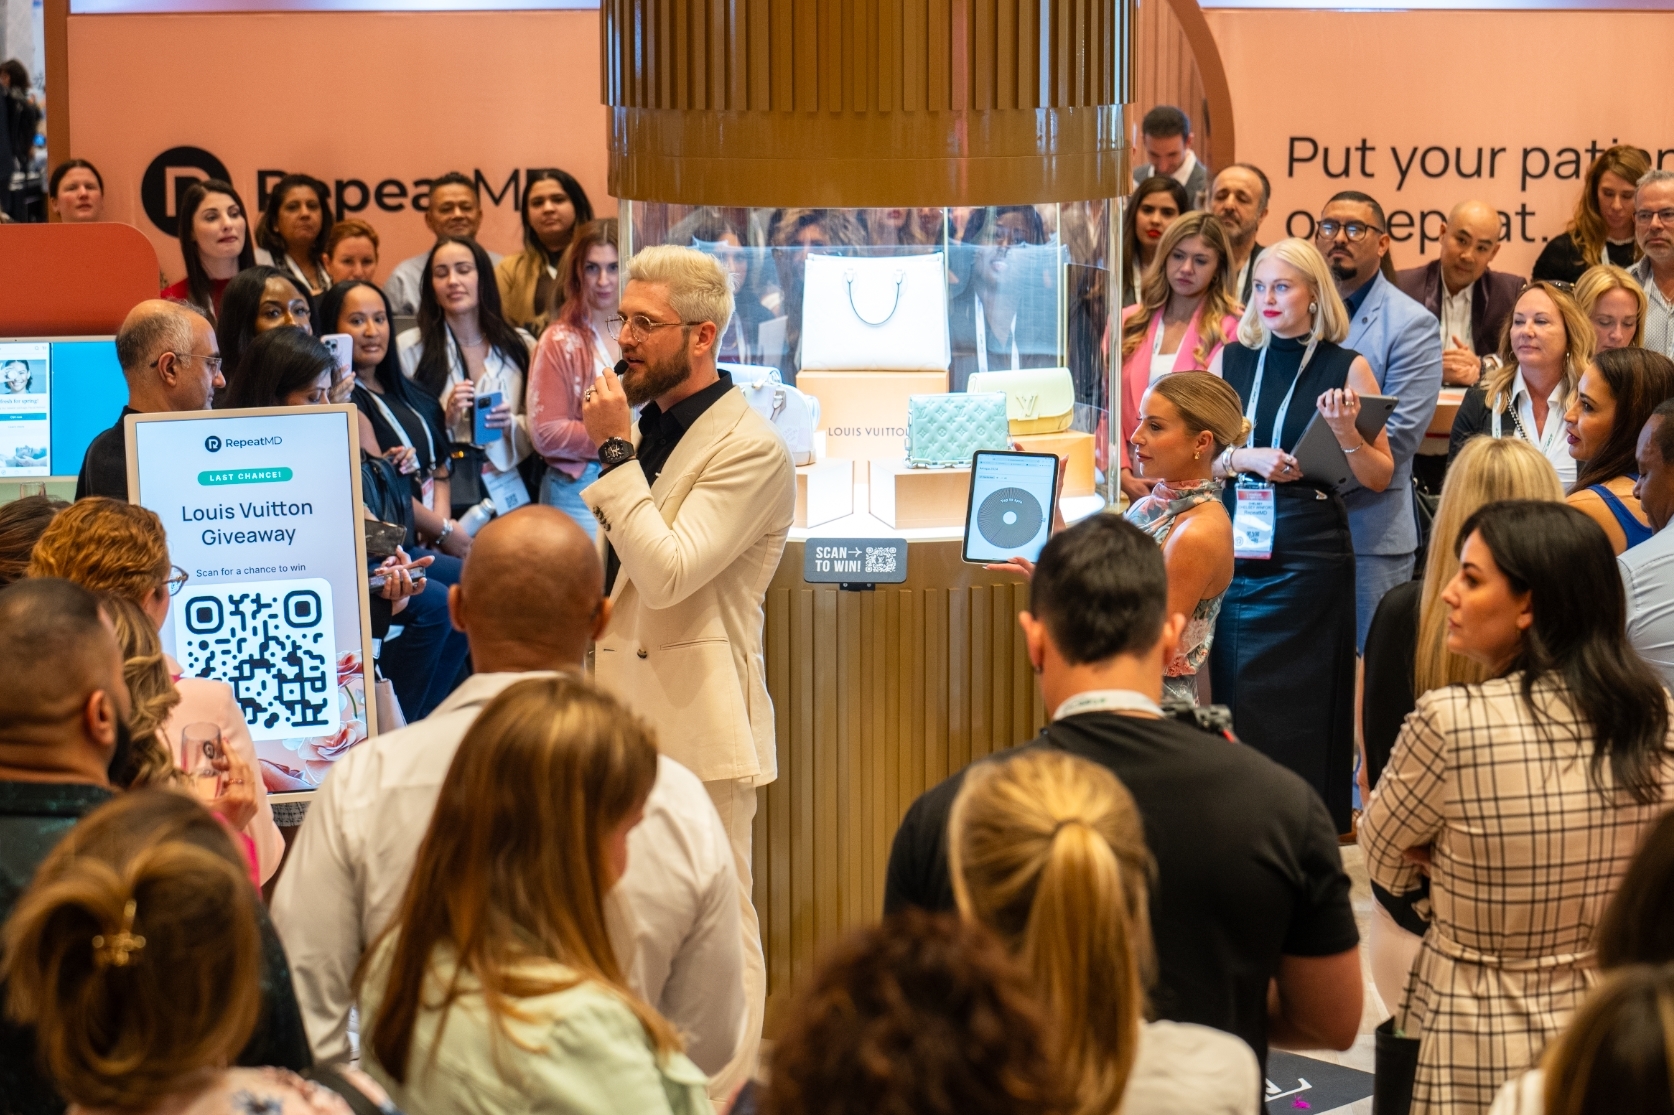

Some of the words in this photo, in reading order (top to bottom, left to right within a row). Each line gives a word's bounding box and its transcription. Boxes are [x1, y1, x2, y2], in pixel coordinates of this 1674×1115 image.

[1287, 136, 1376, 179] Put
[1390, 145, 1507, 191] your
[828, 427, 861, 437] LOUIS
[225, 436, 283, 449] RepeatMD
[209, 473, 234, 482] LAST
[238, 471, 282, 480] CHANCE!
[182, 503, 235, 522] Louis
[239, 500, 313, 519] Vuitton
[201, 528, 296, 546] Giveaway
[815, 546, 847, 559] SCAN
[196, 569, 219, 578] Scan
[221, 567, 233, 576] for
[244, 565, 276, 575] chance
[279, 564, 288, 573] to
[290, 563, 306, 572] win
[815, 560, 830, 572] TO
[834, 560, 861, 573] WIN!
